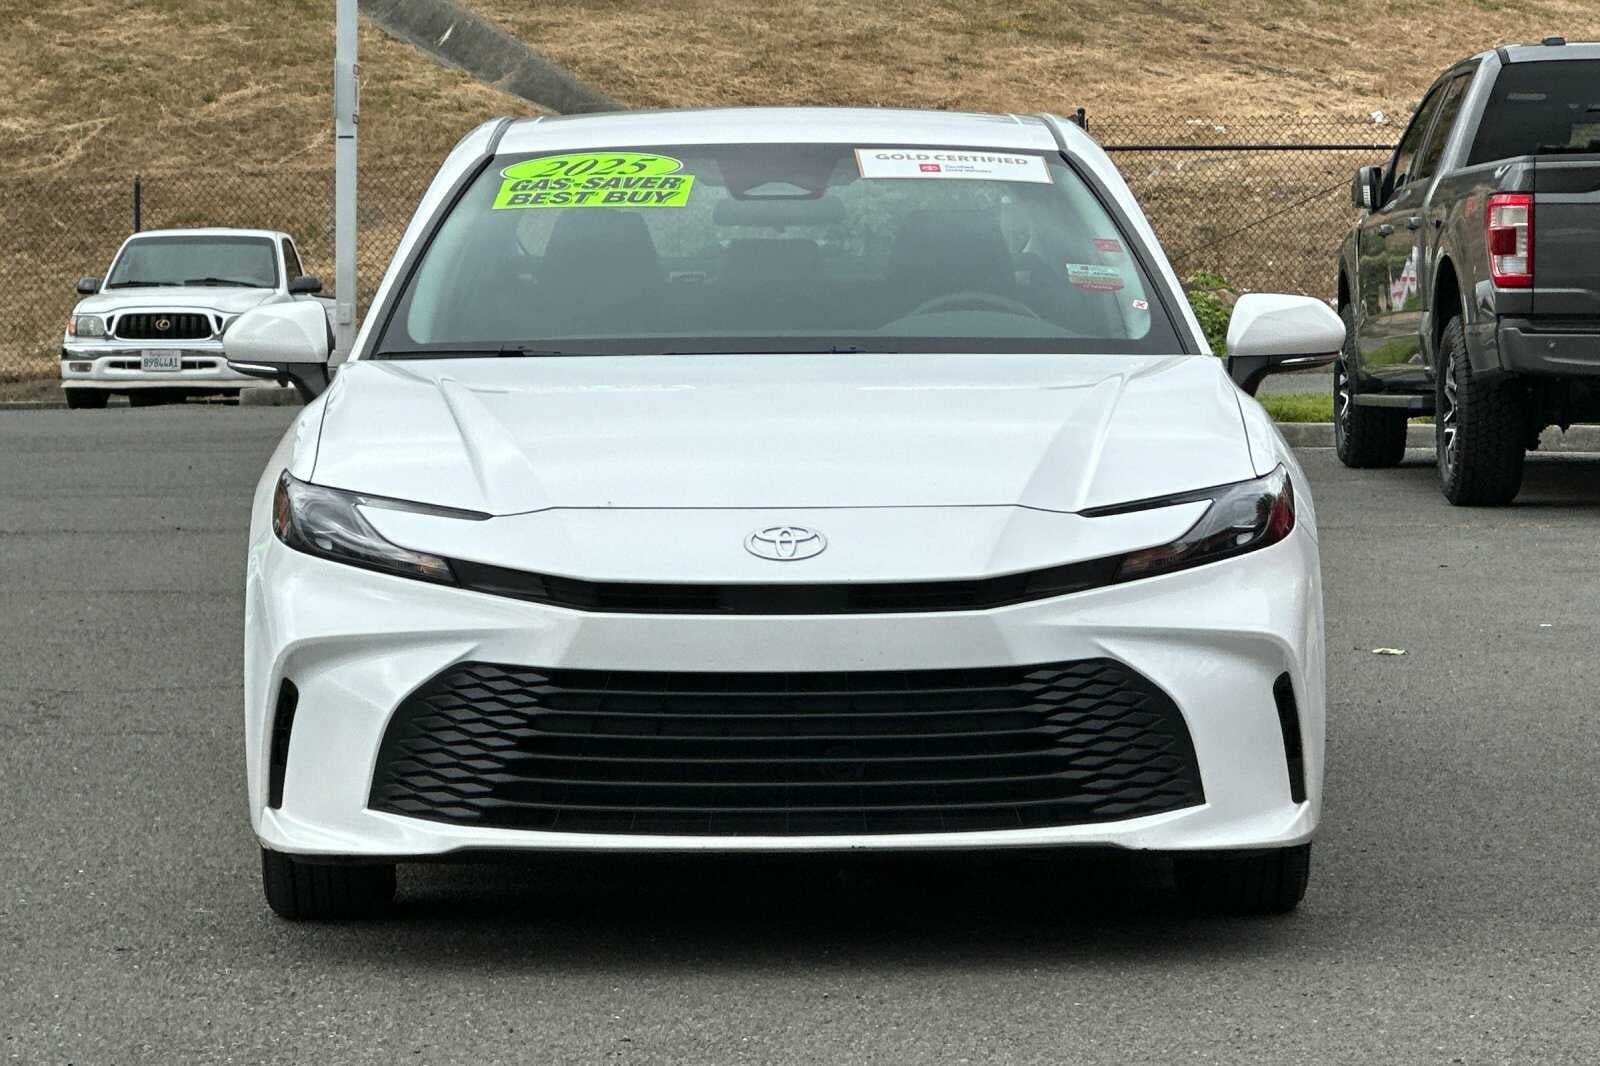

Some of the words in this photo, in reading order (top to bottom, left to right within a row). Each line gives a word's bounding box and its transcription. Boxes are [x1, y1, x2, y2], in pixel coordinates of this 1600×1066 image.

[875, 153, 931, 161] GOLD
[933, 154, 1029, 165] CERTIFIED
[532, 158, 658, 177] 2025
[506, 191, 600, 206] BEST
[601, 190, 681, 205] BUY
